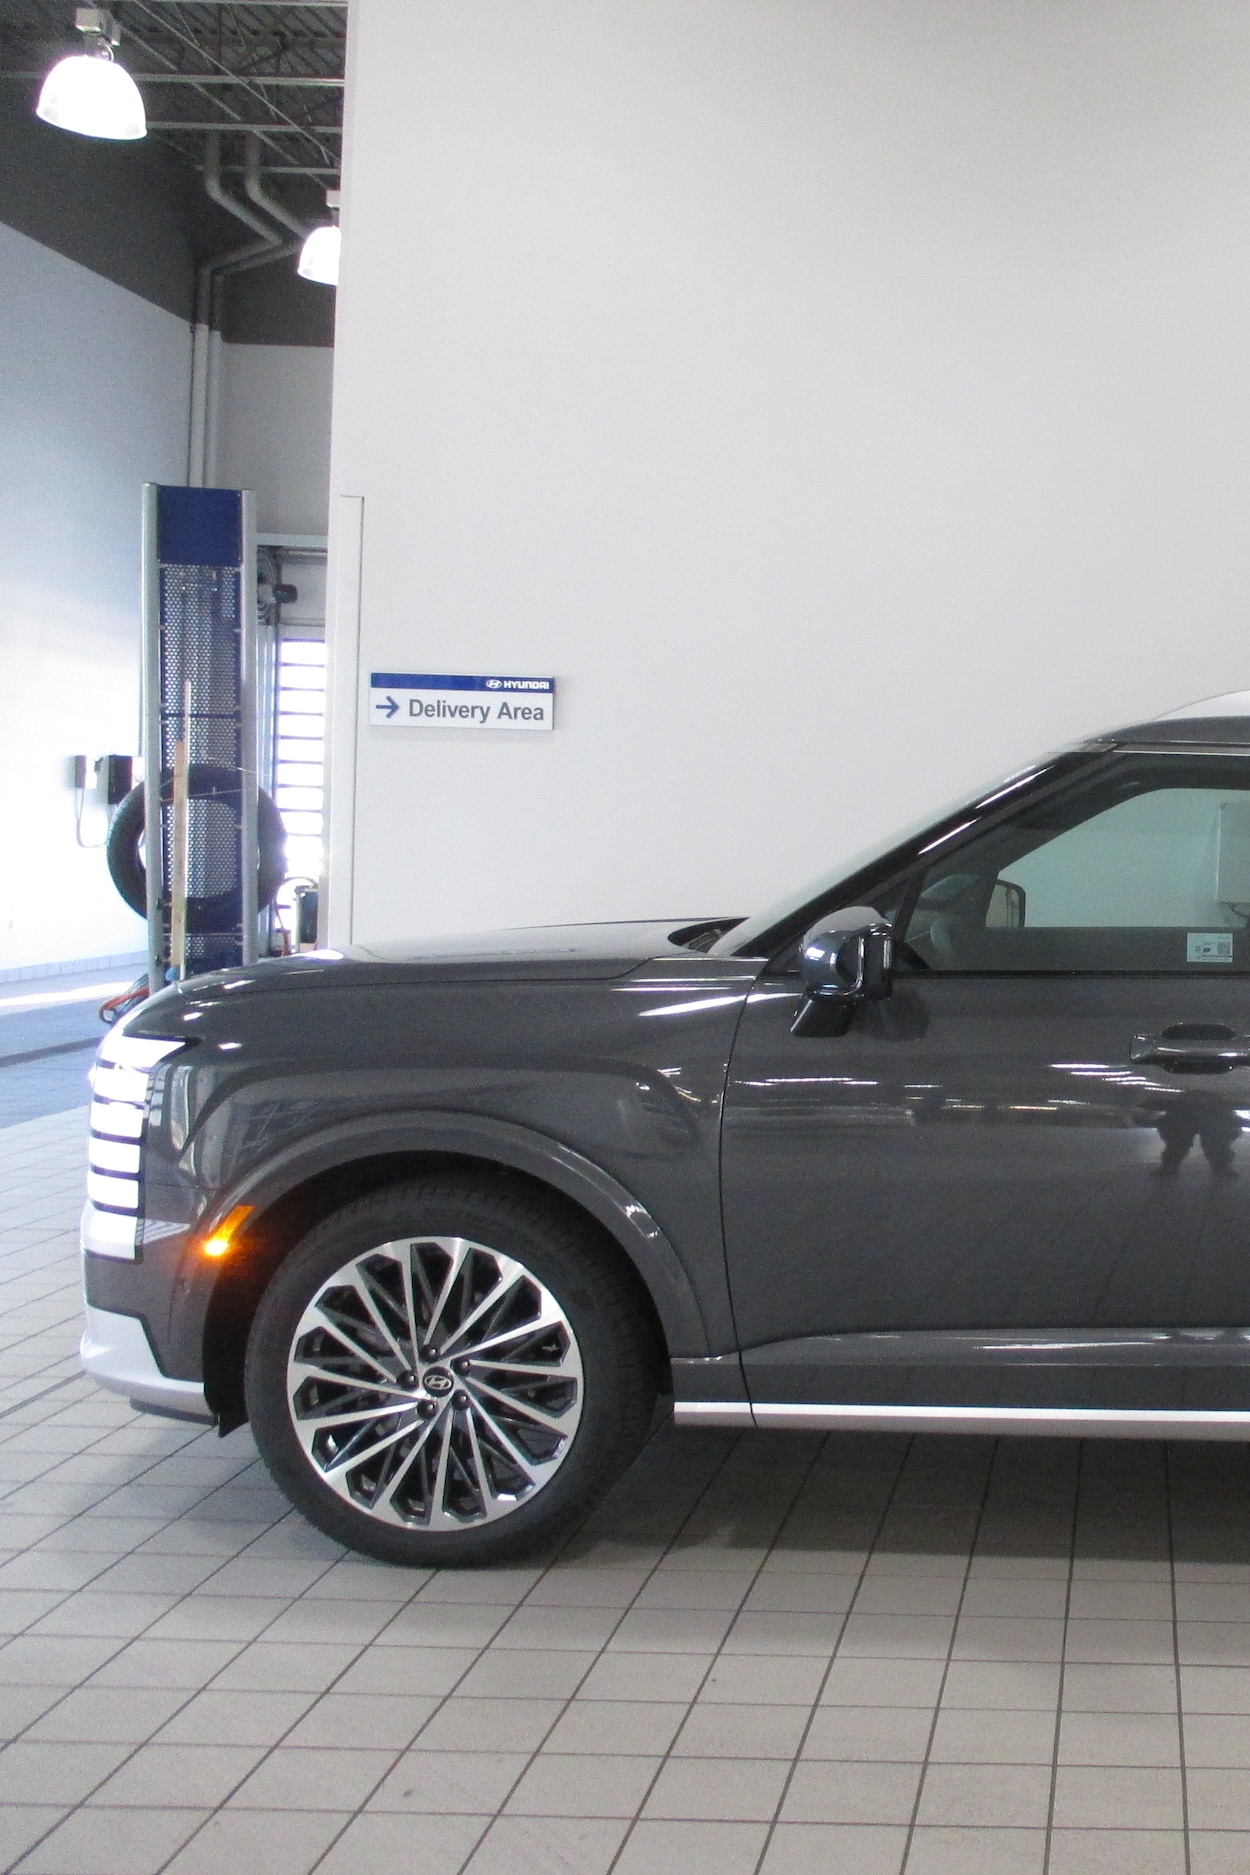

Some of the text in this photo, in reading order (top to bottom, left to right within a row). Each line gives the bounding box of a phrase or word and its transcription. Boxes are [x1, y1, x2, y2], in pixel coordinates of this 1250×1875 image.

[503, 680, 550, 690] HYUNDAI
[408, 698, 544, 724] Delivery Area
